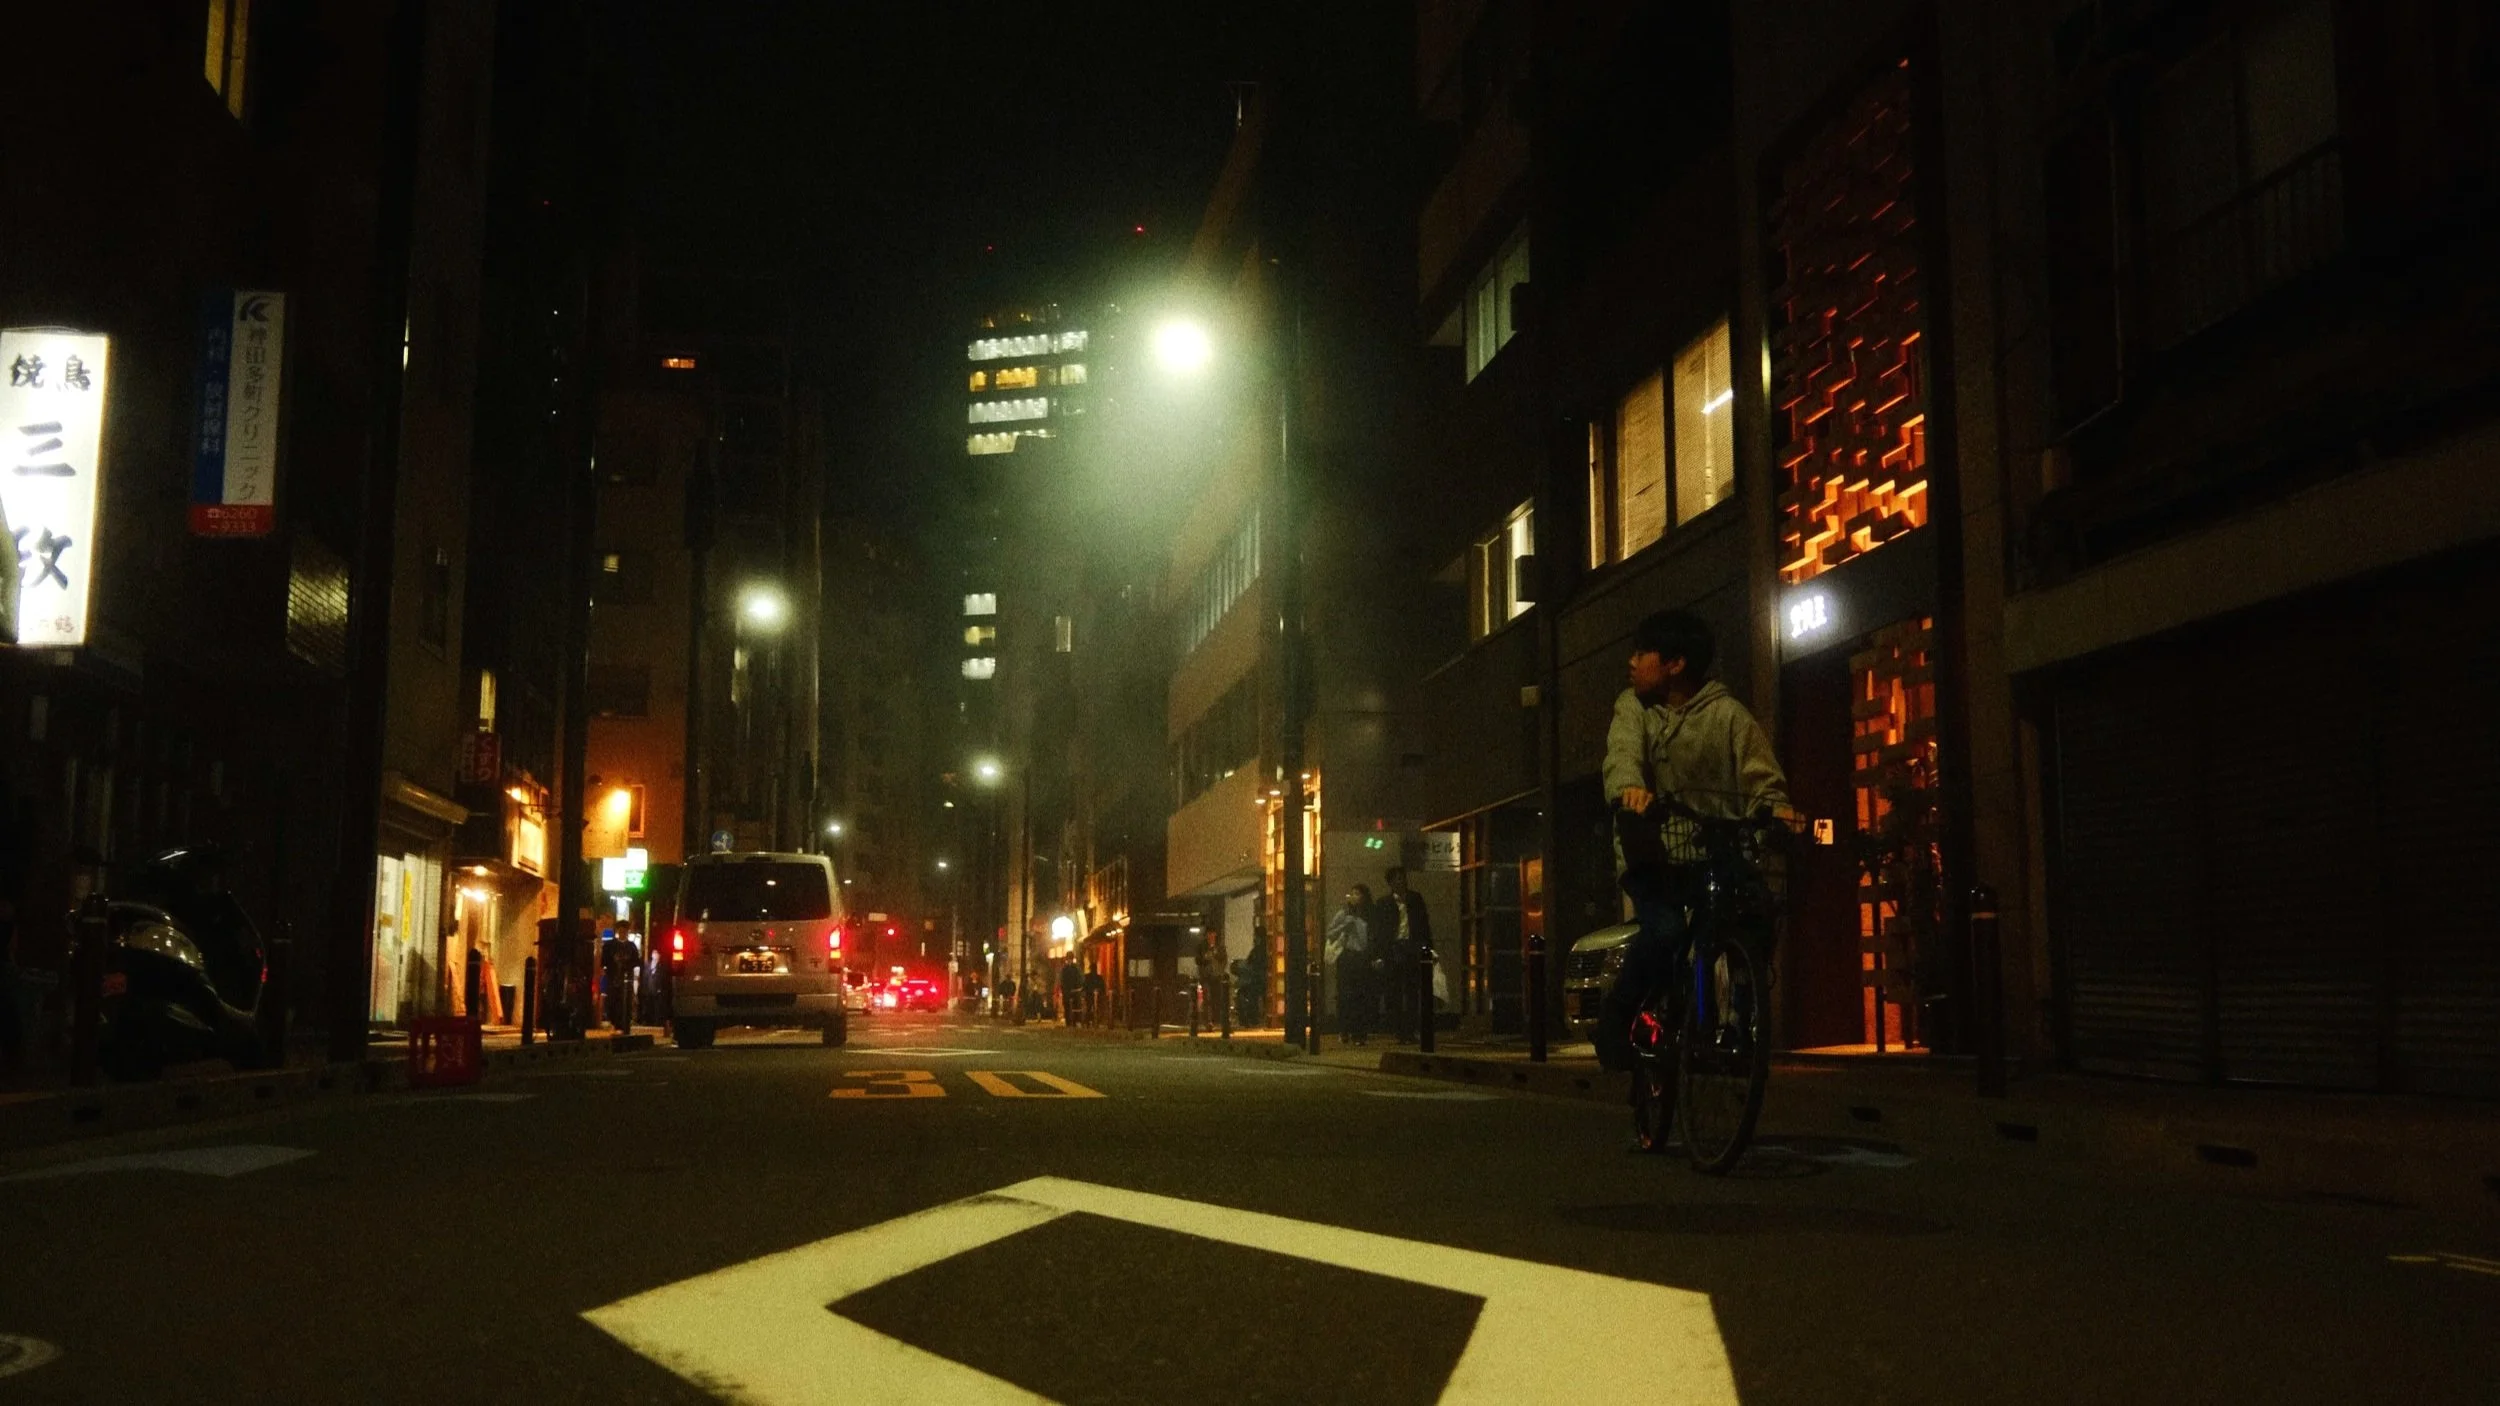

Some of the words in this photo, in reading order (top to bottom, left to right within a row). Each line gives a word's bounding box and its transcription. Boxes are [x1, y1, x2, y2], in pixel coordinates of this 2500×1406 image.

[239, 327, 268, 500] 神田多町クリニック
[828, 1070, 1108, 1098] 30
